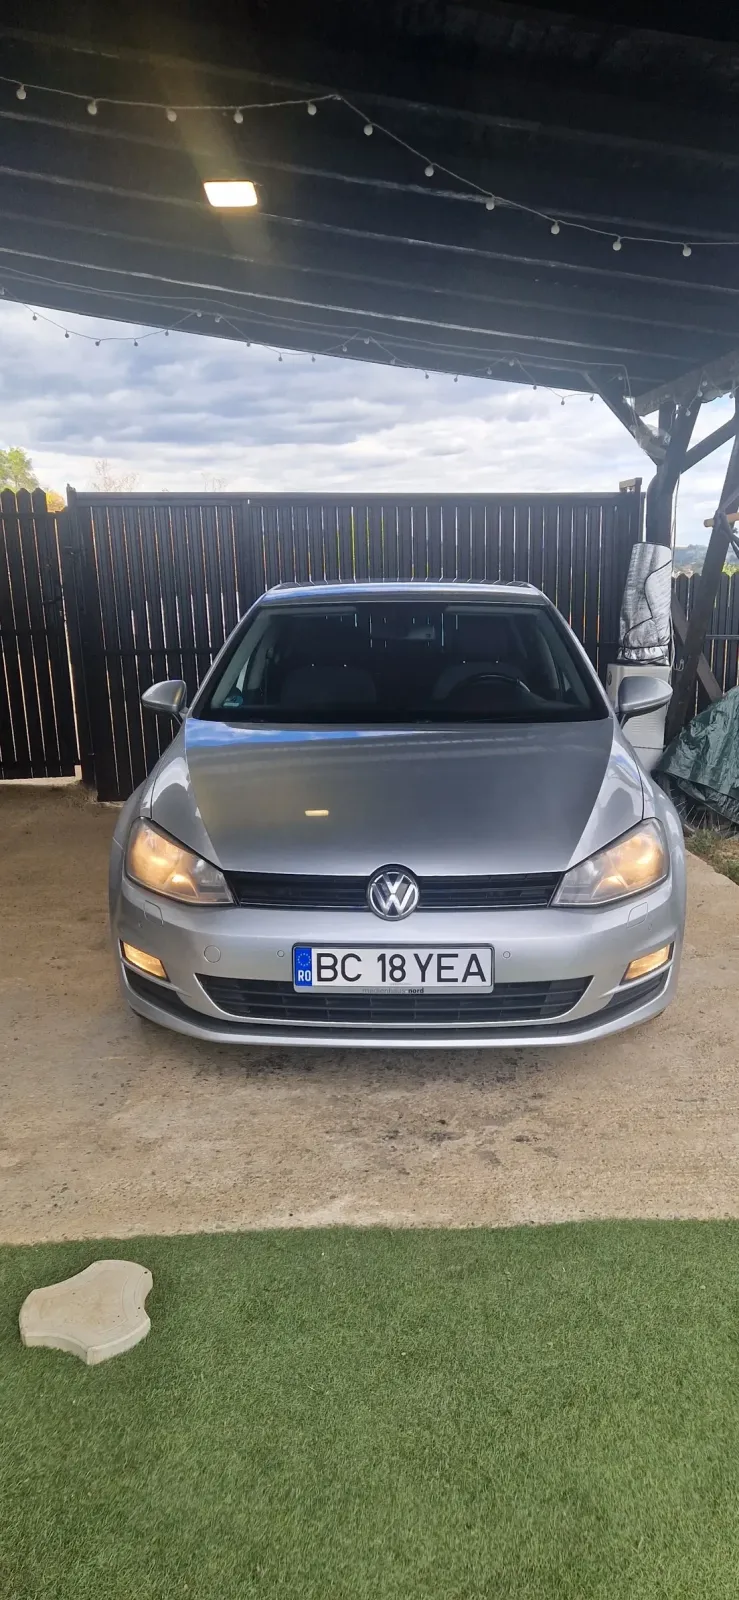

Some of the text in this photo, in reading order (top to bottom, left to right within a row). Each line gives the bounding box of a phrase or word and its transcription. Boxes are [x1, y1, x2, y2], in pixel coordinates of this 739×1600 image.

[369, 872, 417, 917] VW
[297, 970, 312, 982] RO
[316, 952, 487, 983] BC 18 YEA
